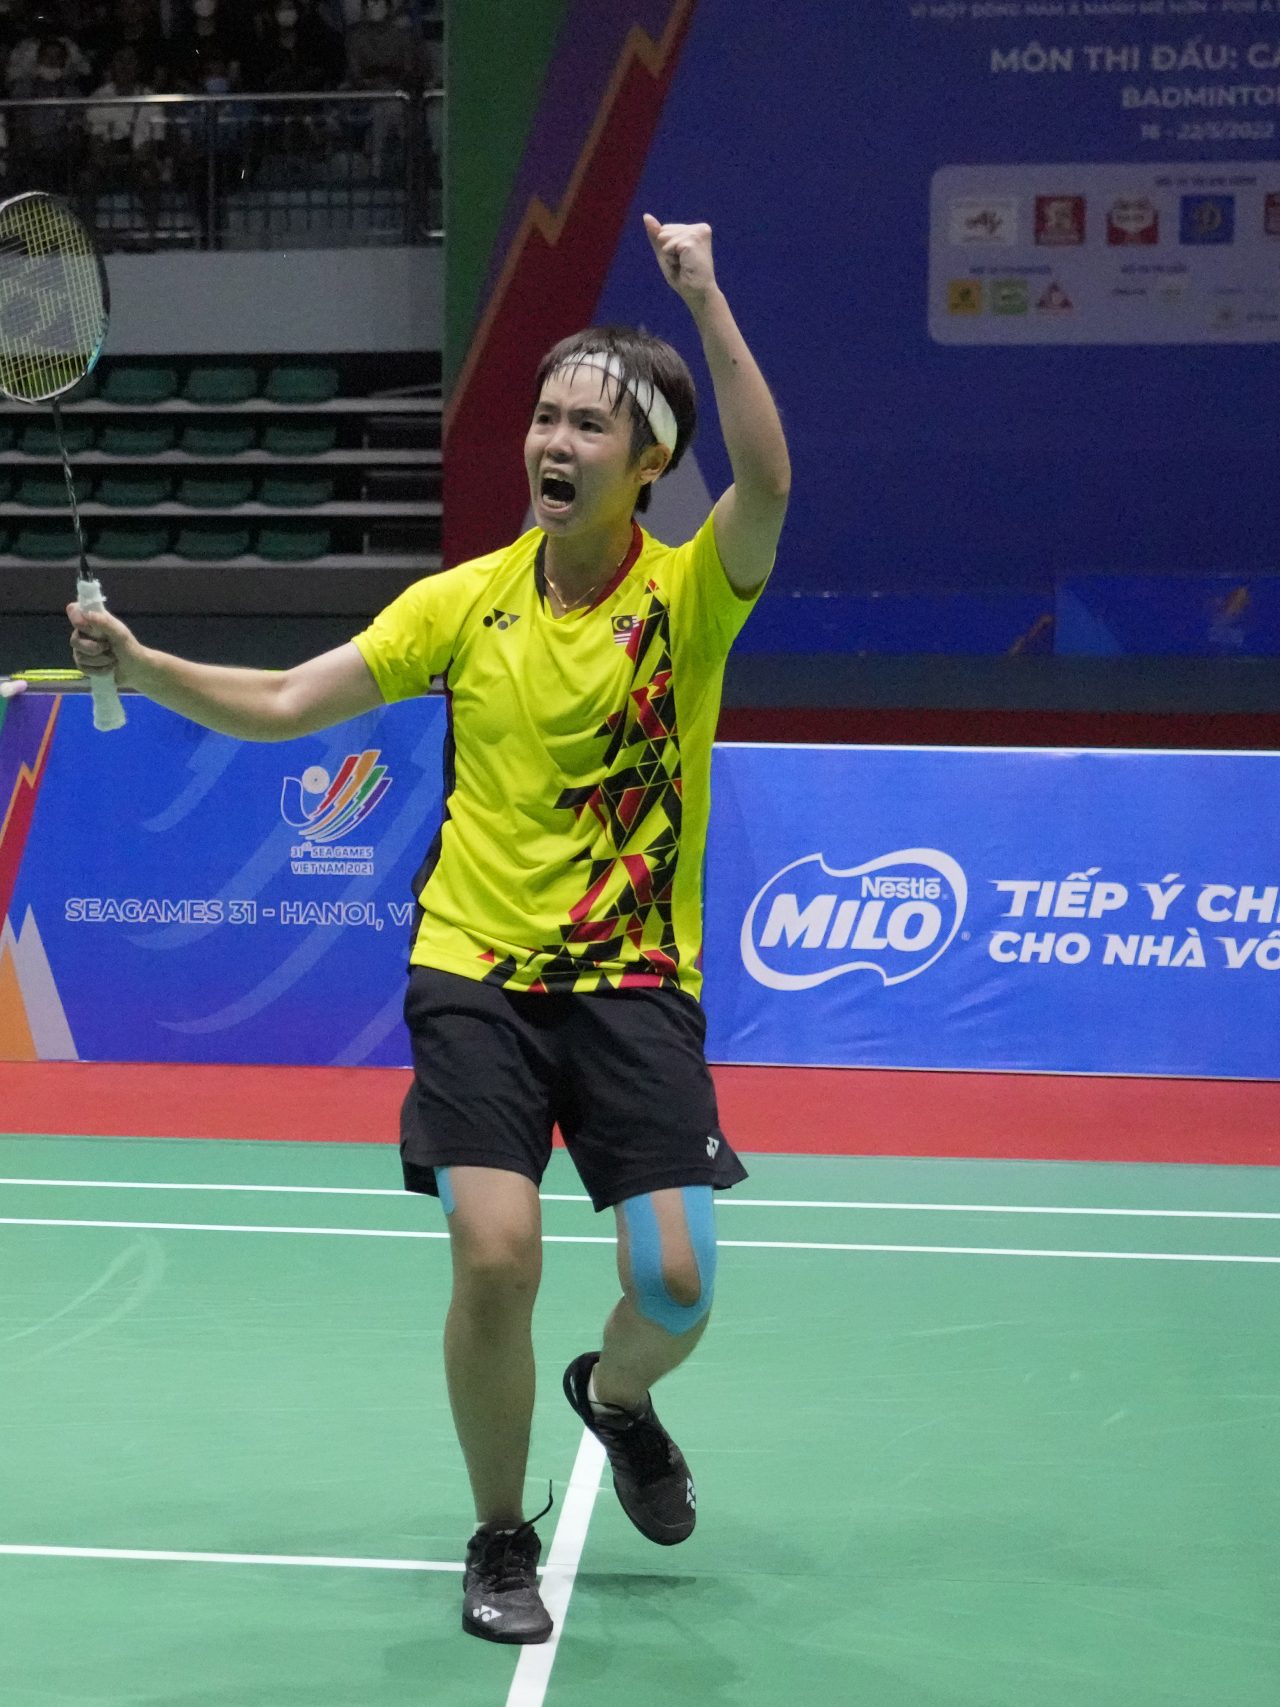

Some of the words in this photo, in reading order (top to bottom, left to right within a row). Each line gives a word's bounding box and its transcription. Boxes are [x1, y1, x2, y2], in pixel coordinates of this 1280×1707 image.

[990, 40, 1073, 73] MÔN
[1083, 45, 1140, 72] THI
[1122, 84, 1280, 108] BADMINTO
[311, 846, 334, 859] SEA
[334, 846, 374, 859] GAMES
[346, 862, 374, 875] 2021
[988, 866, 1128, 919] TIẾP
[1137, 872, 1185, 921] Ý
[1197, 883, 1280, 924] CH
[65, 898, 222, 922] SEAGAMES
[229, 900, 258, 924] 31
[280, 901, 384, 931] HANOI,
[759, 893, 942, 952] MILO
[988, 931, 1091, 965] CHO
[1102, 927, 1207, 968] NHÀ
